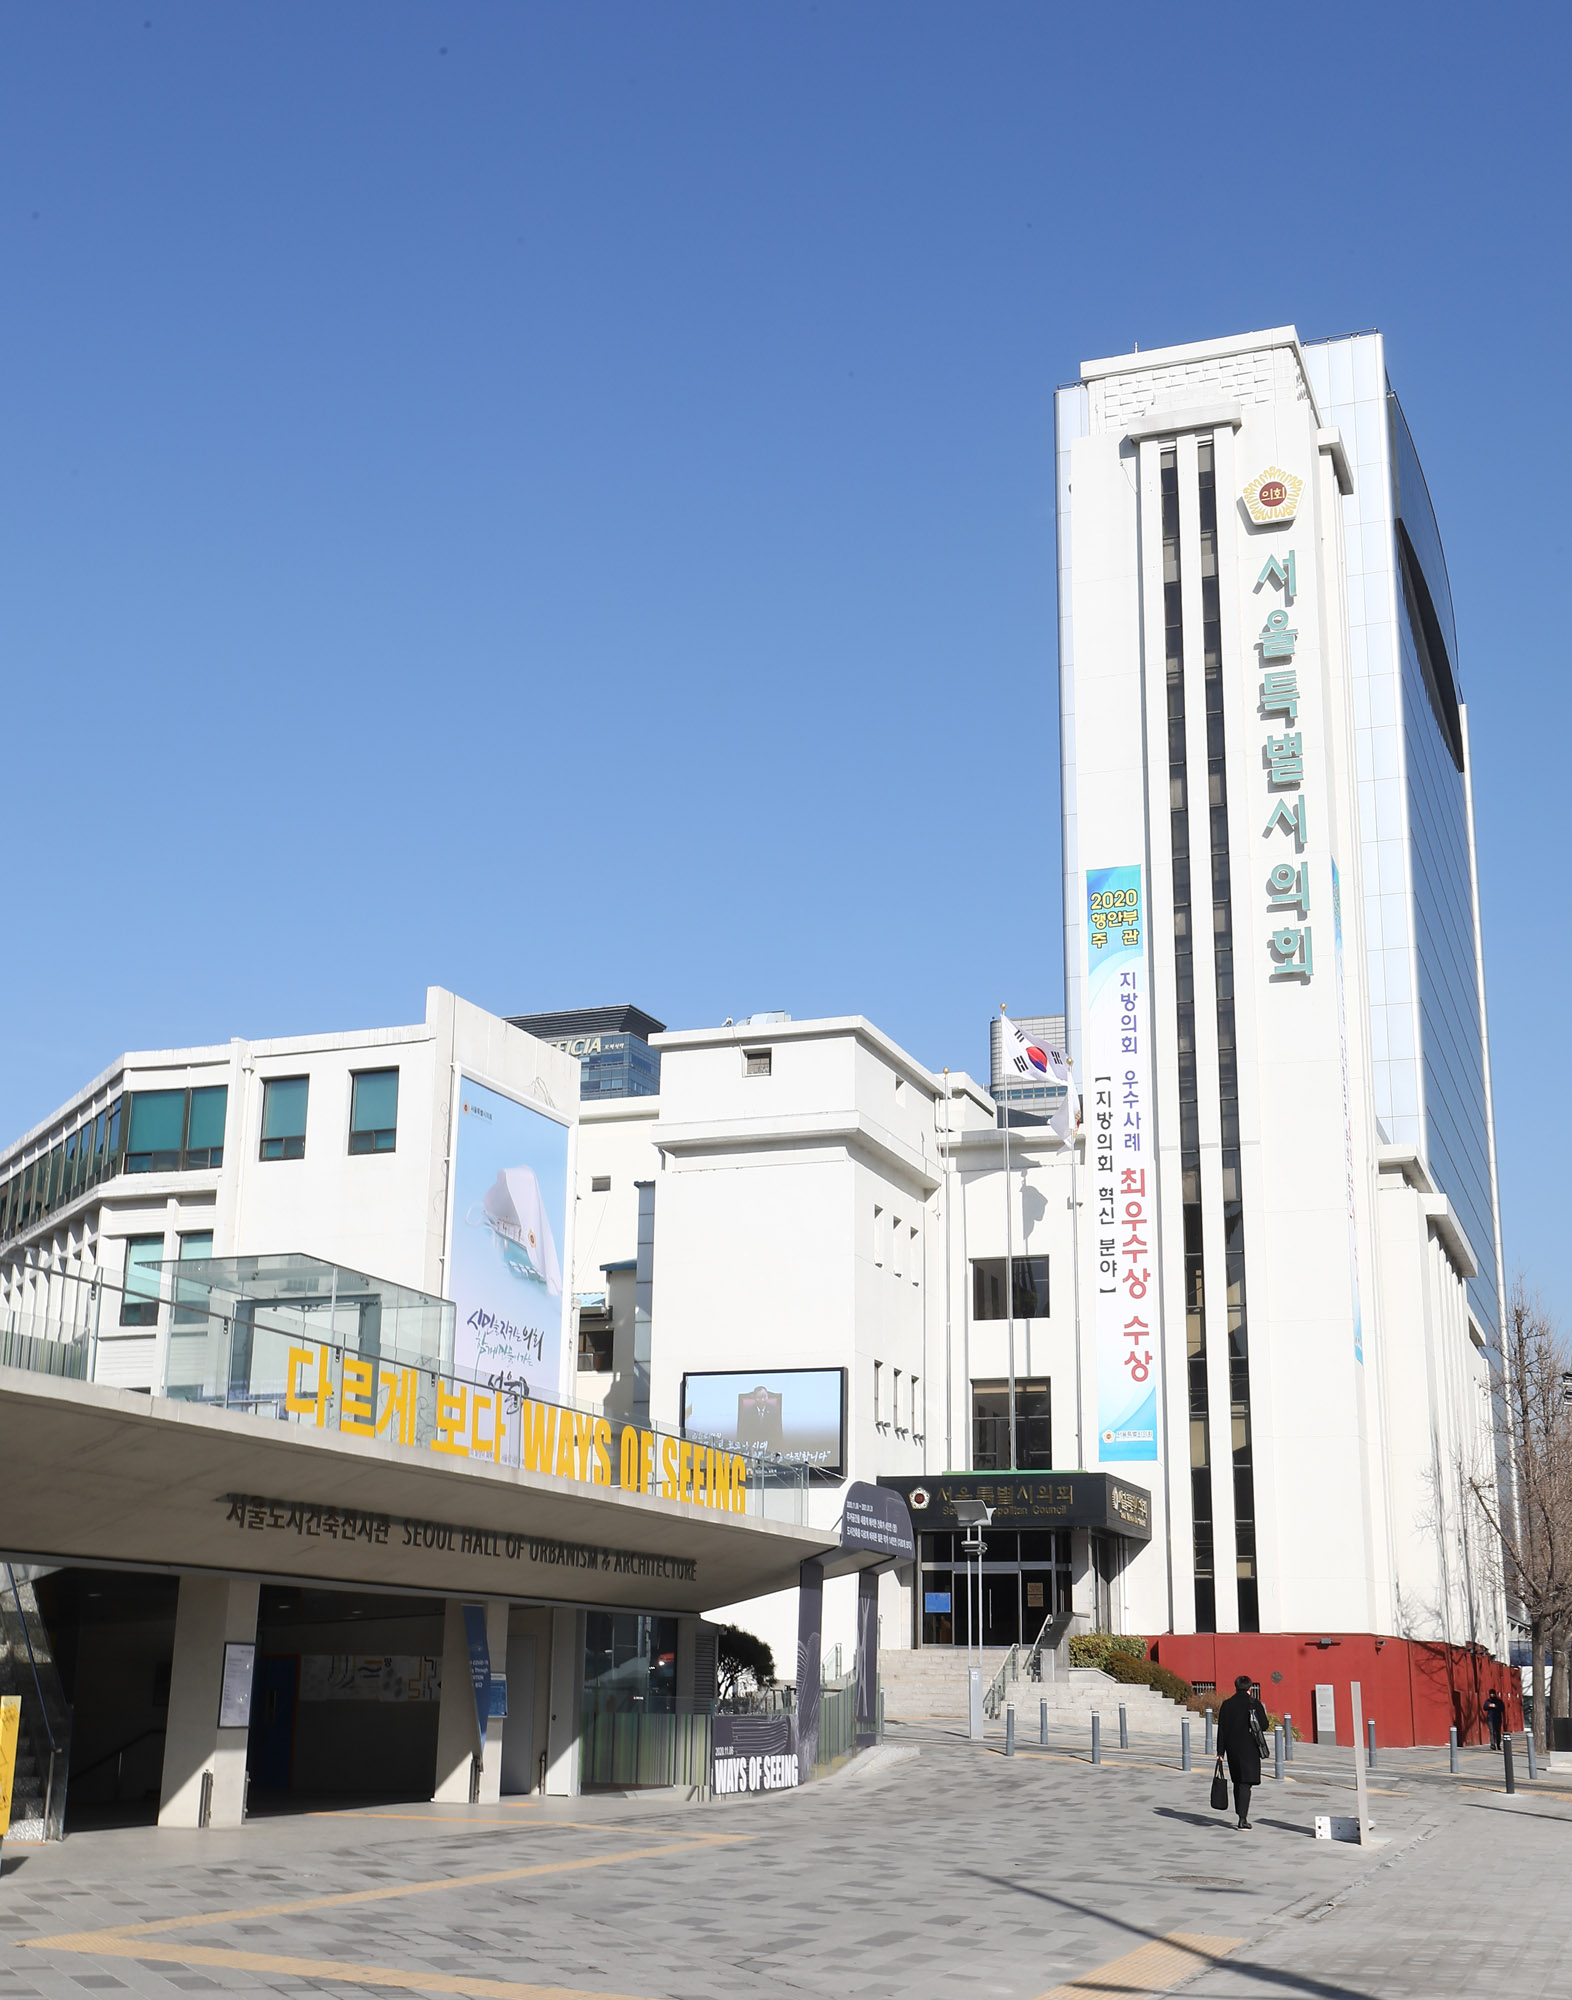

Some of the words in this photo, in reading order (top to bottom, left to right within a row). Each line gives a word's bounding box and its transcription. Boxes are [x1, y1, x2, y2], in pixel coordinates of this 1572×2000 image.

[1261, 487, 1285, 501] 의회
[1259, 549, 1313, 979] 서울특별시의회
[1090, 889, 1138, 910] 2020
[1091, 910, 1139, 929] 행안부
[1119, 971, 1138, 1054] 지방의회
[1122, 1070, 1142, 1152] 우수사례
[1099, 1187, 1115, 1225] 혁신
[1120, 1167, 1150, 1300] 최우수상
[522, 1326, 545, 1362] 의회
[1123, 1316, 1153, 1382] 수상
[487, 1370, 530, 1415] 서울
[286, 1344, 418, 1447] 다르게
[430, 1380, 506, 1464] 보다
[523, 1399, 612, 1488] WAYS
[620, 1425, 654, 1495] OF
[662, 1436, 746, 1514] SEEING
[1032, 1505, 1067, 1516] Council
[226, 1498, 391, 1545] 서울도시건축전시관
[402, 1519, 456, 1552] SEOUL
[460, 1529, 500, 1557] HALL
[505, 1534, 525, 1560] OF
[529, 1541, 598, 1570] URBANISM
[613, 1552, 697, 1582] ARCHITECTURE
[715, 1757, 747, 1794] WAYS
[748, 1756, 763, 1791] OF
[763, 1753, 799, 1789] SEEING
